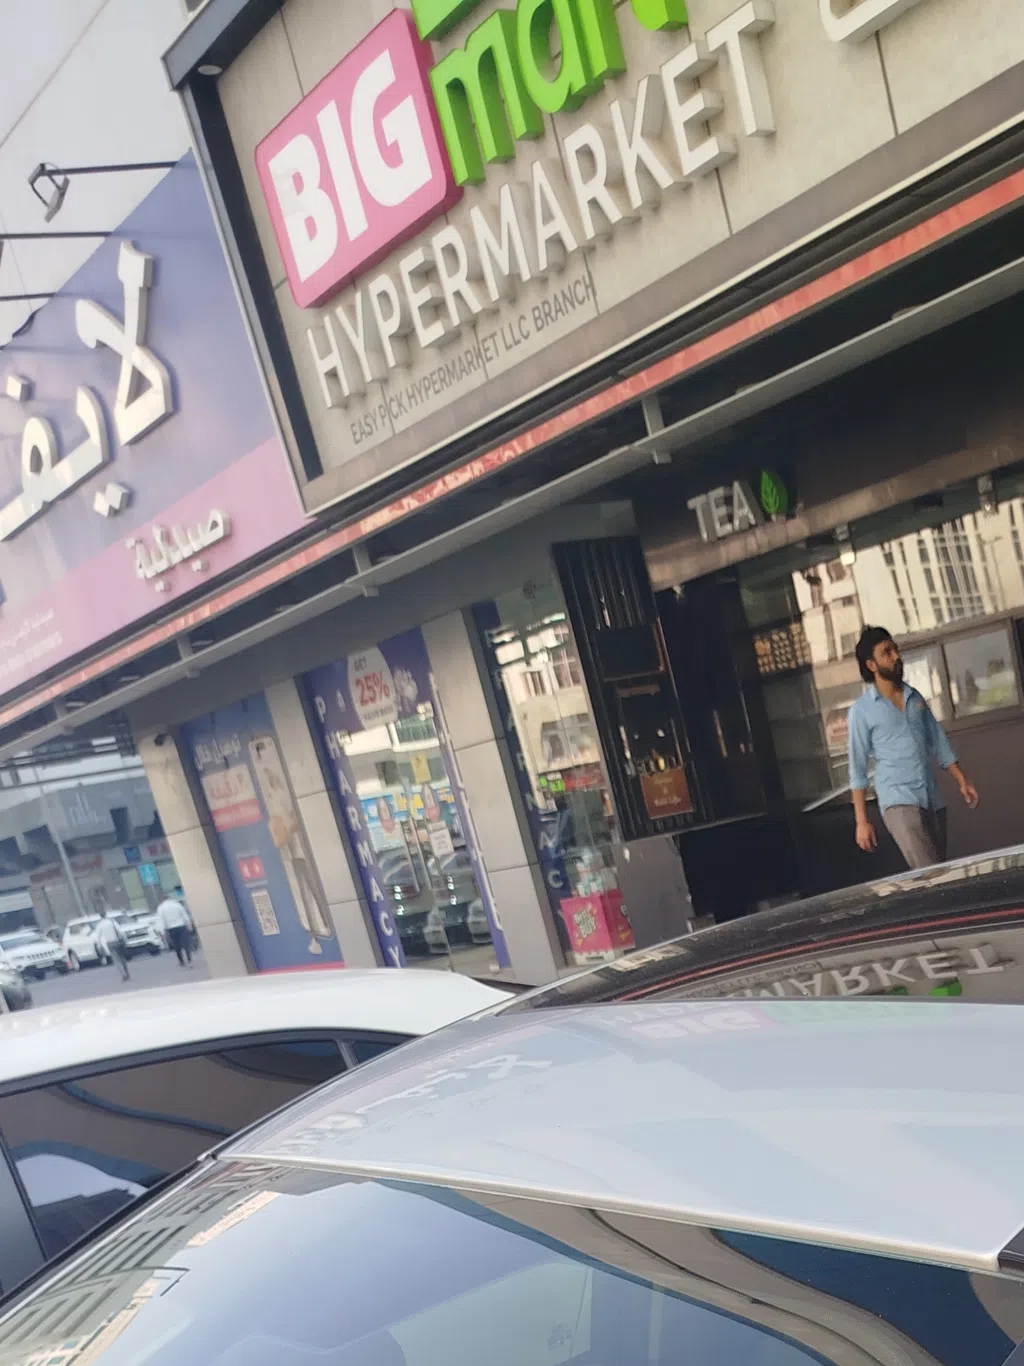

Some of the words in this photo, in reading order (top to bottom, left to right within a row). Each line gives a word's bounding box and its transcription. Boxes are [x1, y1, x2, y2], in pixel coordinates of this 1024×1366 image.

[268, 48, 433, 283] BIG
[306, 0, 775, 410] HYPERMARKET
[350, 409, 380, 444] EASY
[378, 392, 408, 426] PICK
[406, 332, 499, 410] HYPERMARKET
[499, 315, 531, 351] LLC
[531, 274, 598, 333] BRANCH
[125, 508, 230, 592] صيدلية
[687, 480, 759, 543] TEA
[355, 671, 390, 706] 25%
